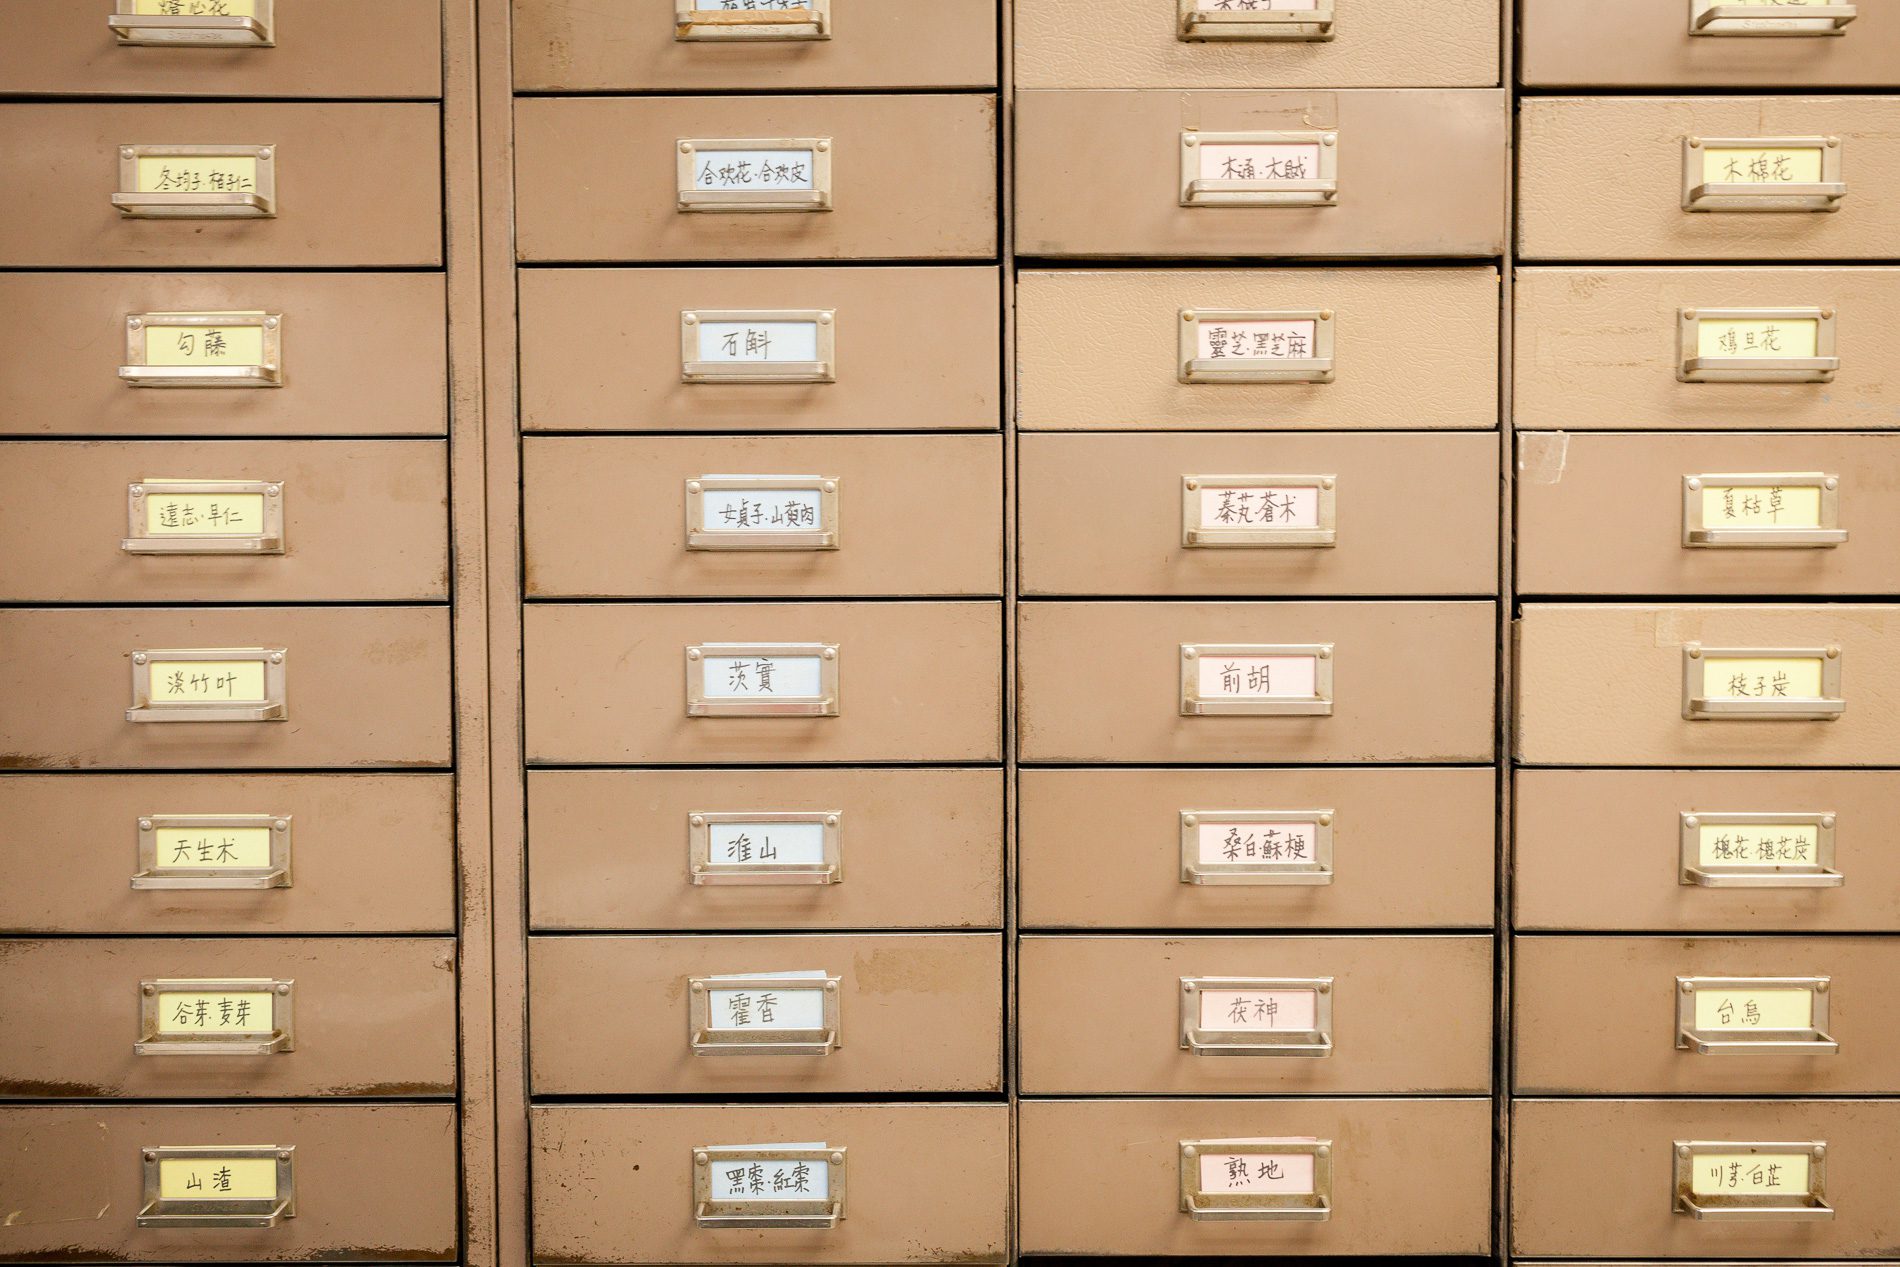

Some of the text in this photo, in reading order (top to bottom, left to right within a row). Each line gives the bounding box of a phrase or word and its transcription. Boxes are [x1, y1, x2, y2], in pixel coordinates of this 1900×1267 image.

[1724, 153, 1792, 181] 木棉花
[168, 671, 237, 697] 淡竹叶
[1220, 662, 1269, 693] 前胡
[728, 833, 776, 862] 淮山
[1228, 997, 1277, 1027] 茯神
[1224, 1157, 1284, 1187] 熟地
